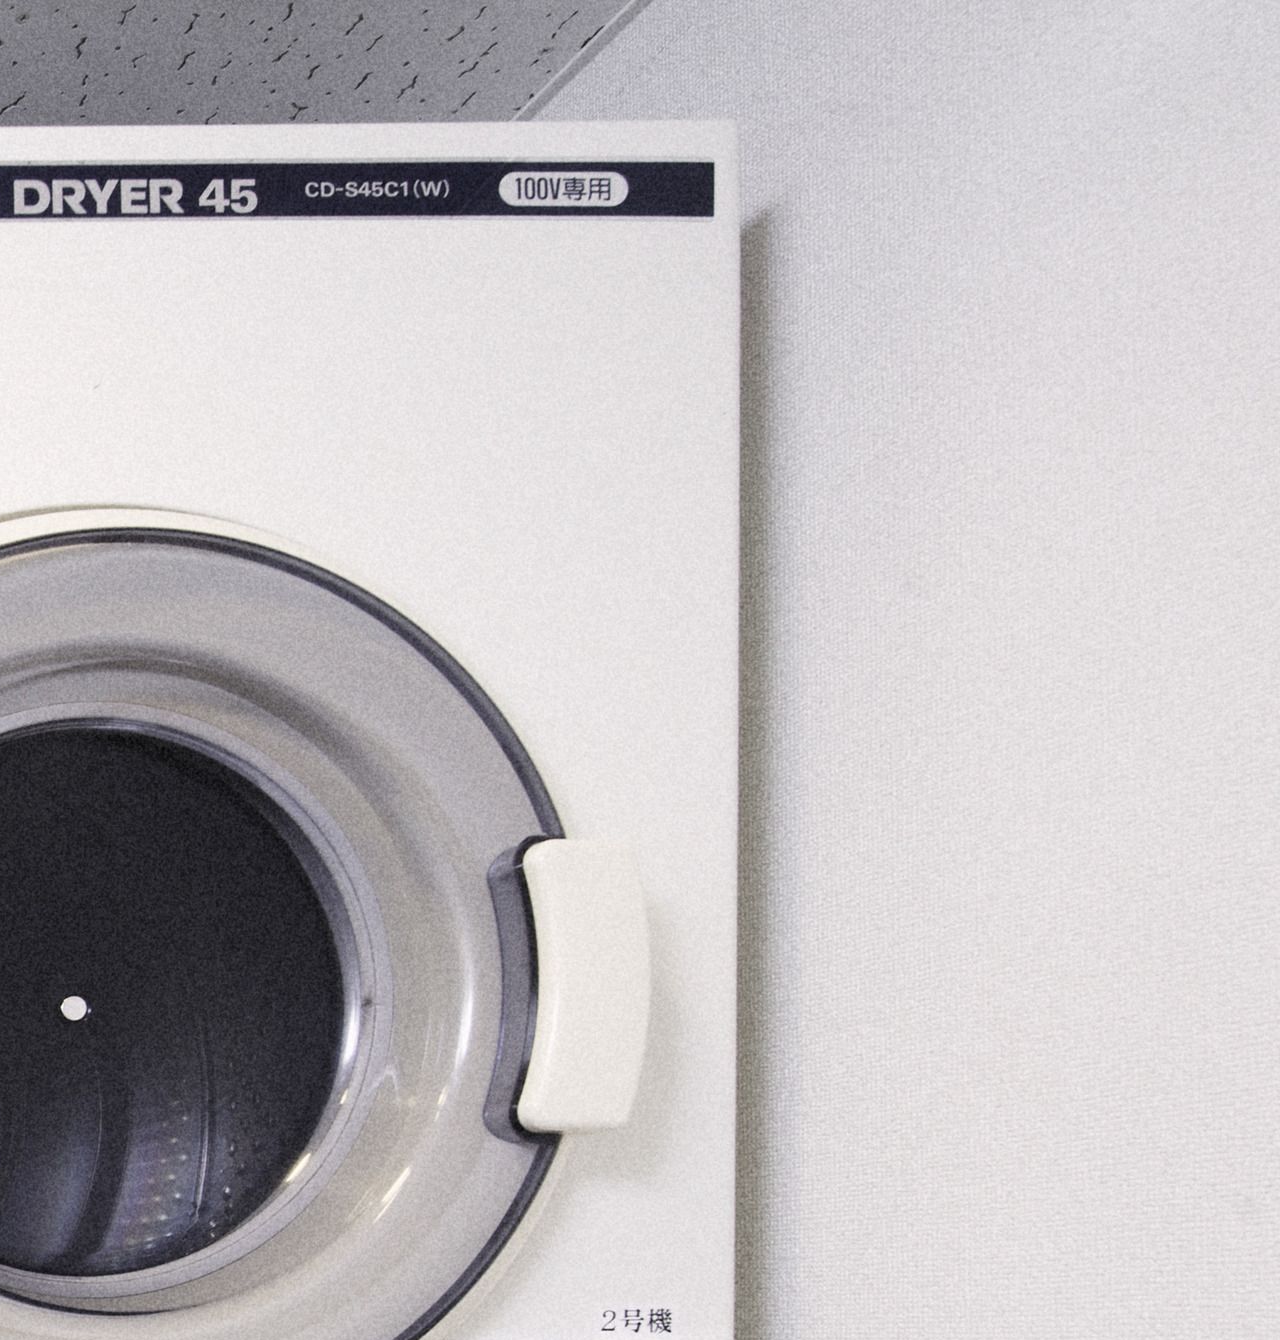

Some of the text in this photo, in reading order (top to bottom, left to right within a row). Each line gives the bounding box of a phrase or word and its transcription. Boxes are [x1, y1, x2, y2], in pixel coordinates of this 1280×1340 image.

[13, 178, 184, 216] DRYER
[198, 178, 258, 214] 45
[304, 178, 451, 200] CD-S45C1(W)
[514, 177, 612, 202] 100V専用
[601, 1308, 673, 1334] 2号機
